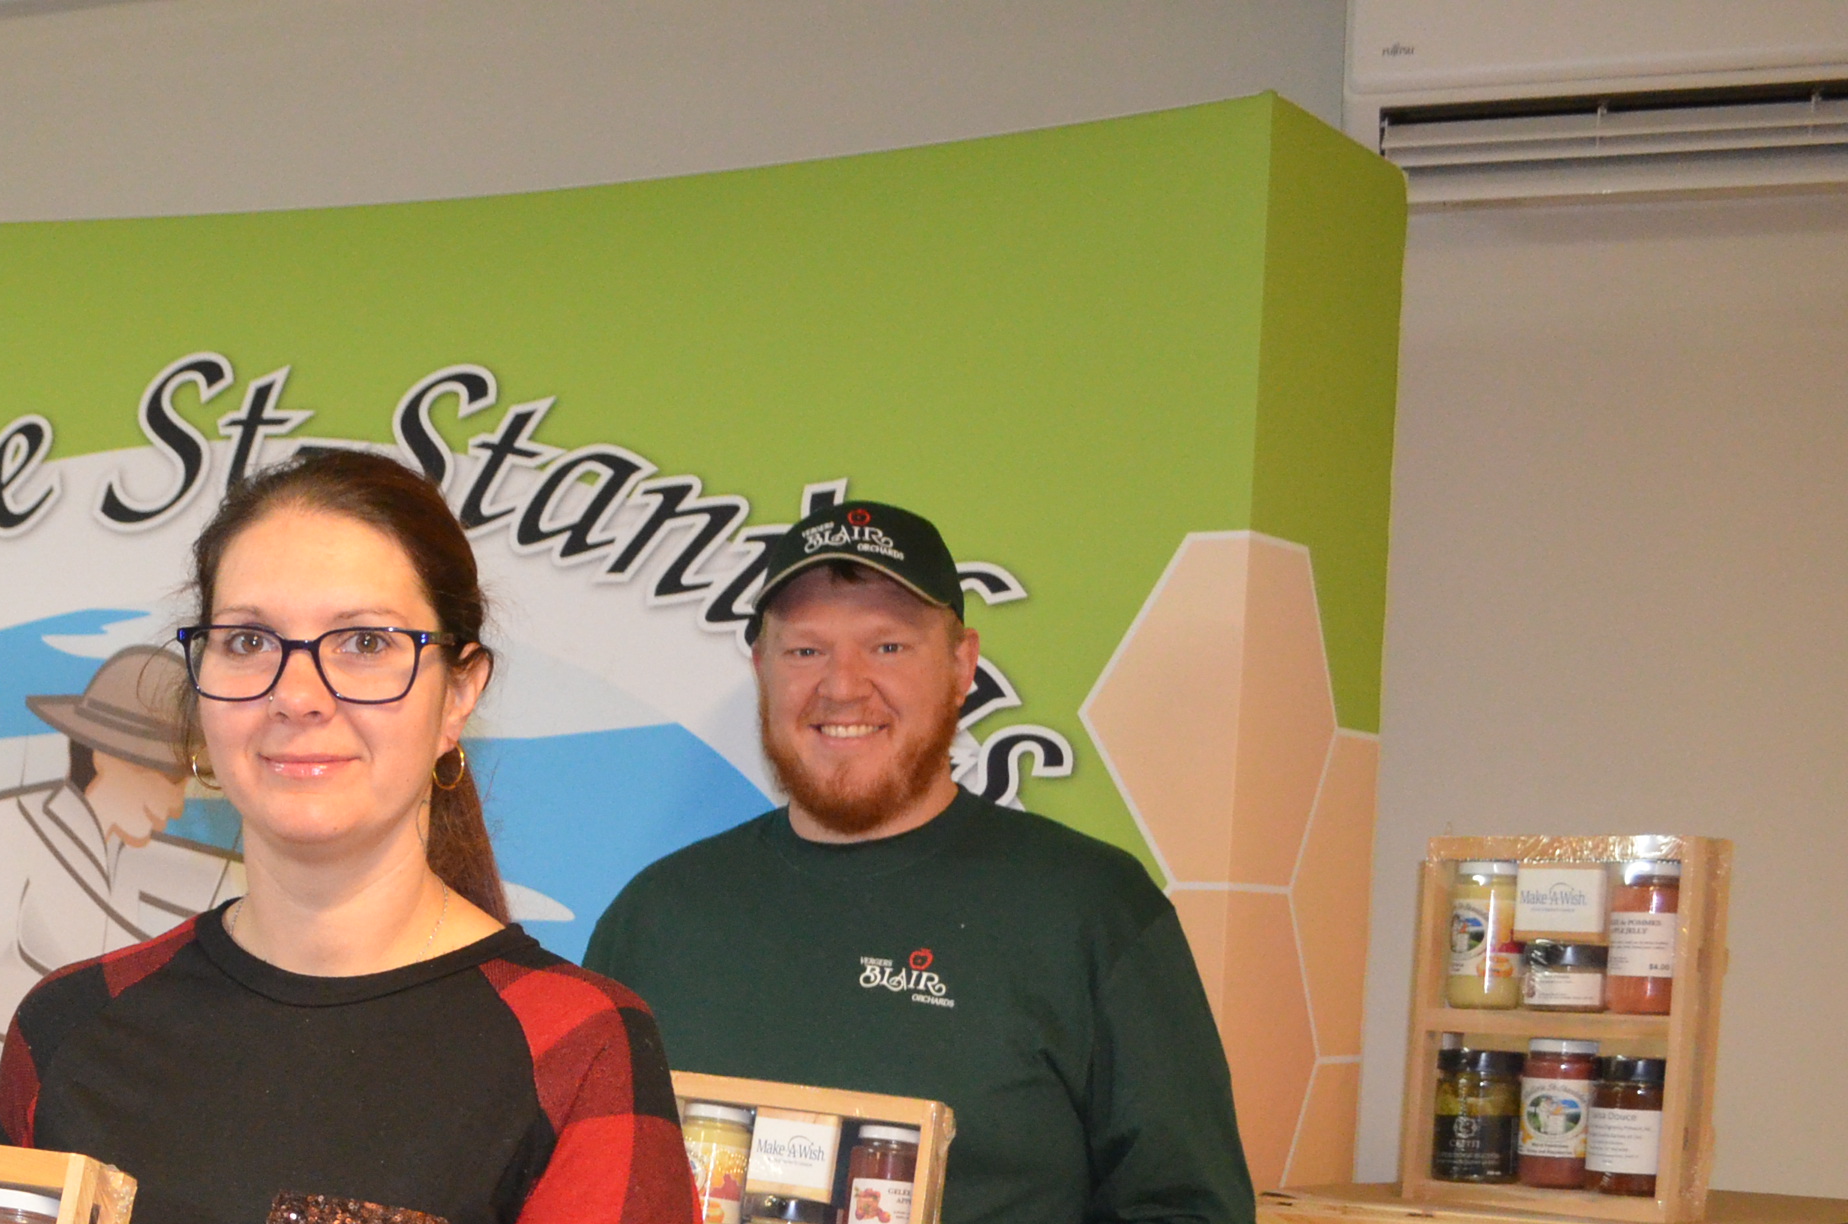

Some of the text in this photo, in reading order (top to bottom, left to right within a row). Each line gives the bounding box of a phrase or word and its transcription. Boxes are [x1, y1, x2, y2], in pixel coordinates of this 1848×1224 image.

[804, 524, 894, 554] BLAIR
[857, 542, 905, 561] ORCHARDS
[859, 967, 947, 997] BLAIR
[911, 992, 956, 1008] ORCHARDS
